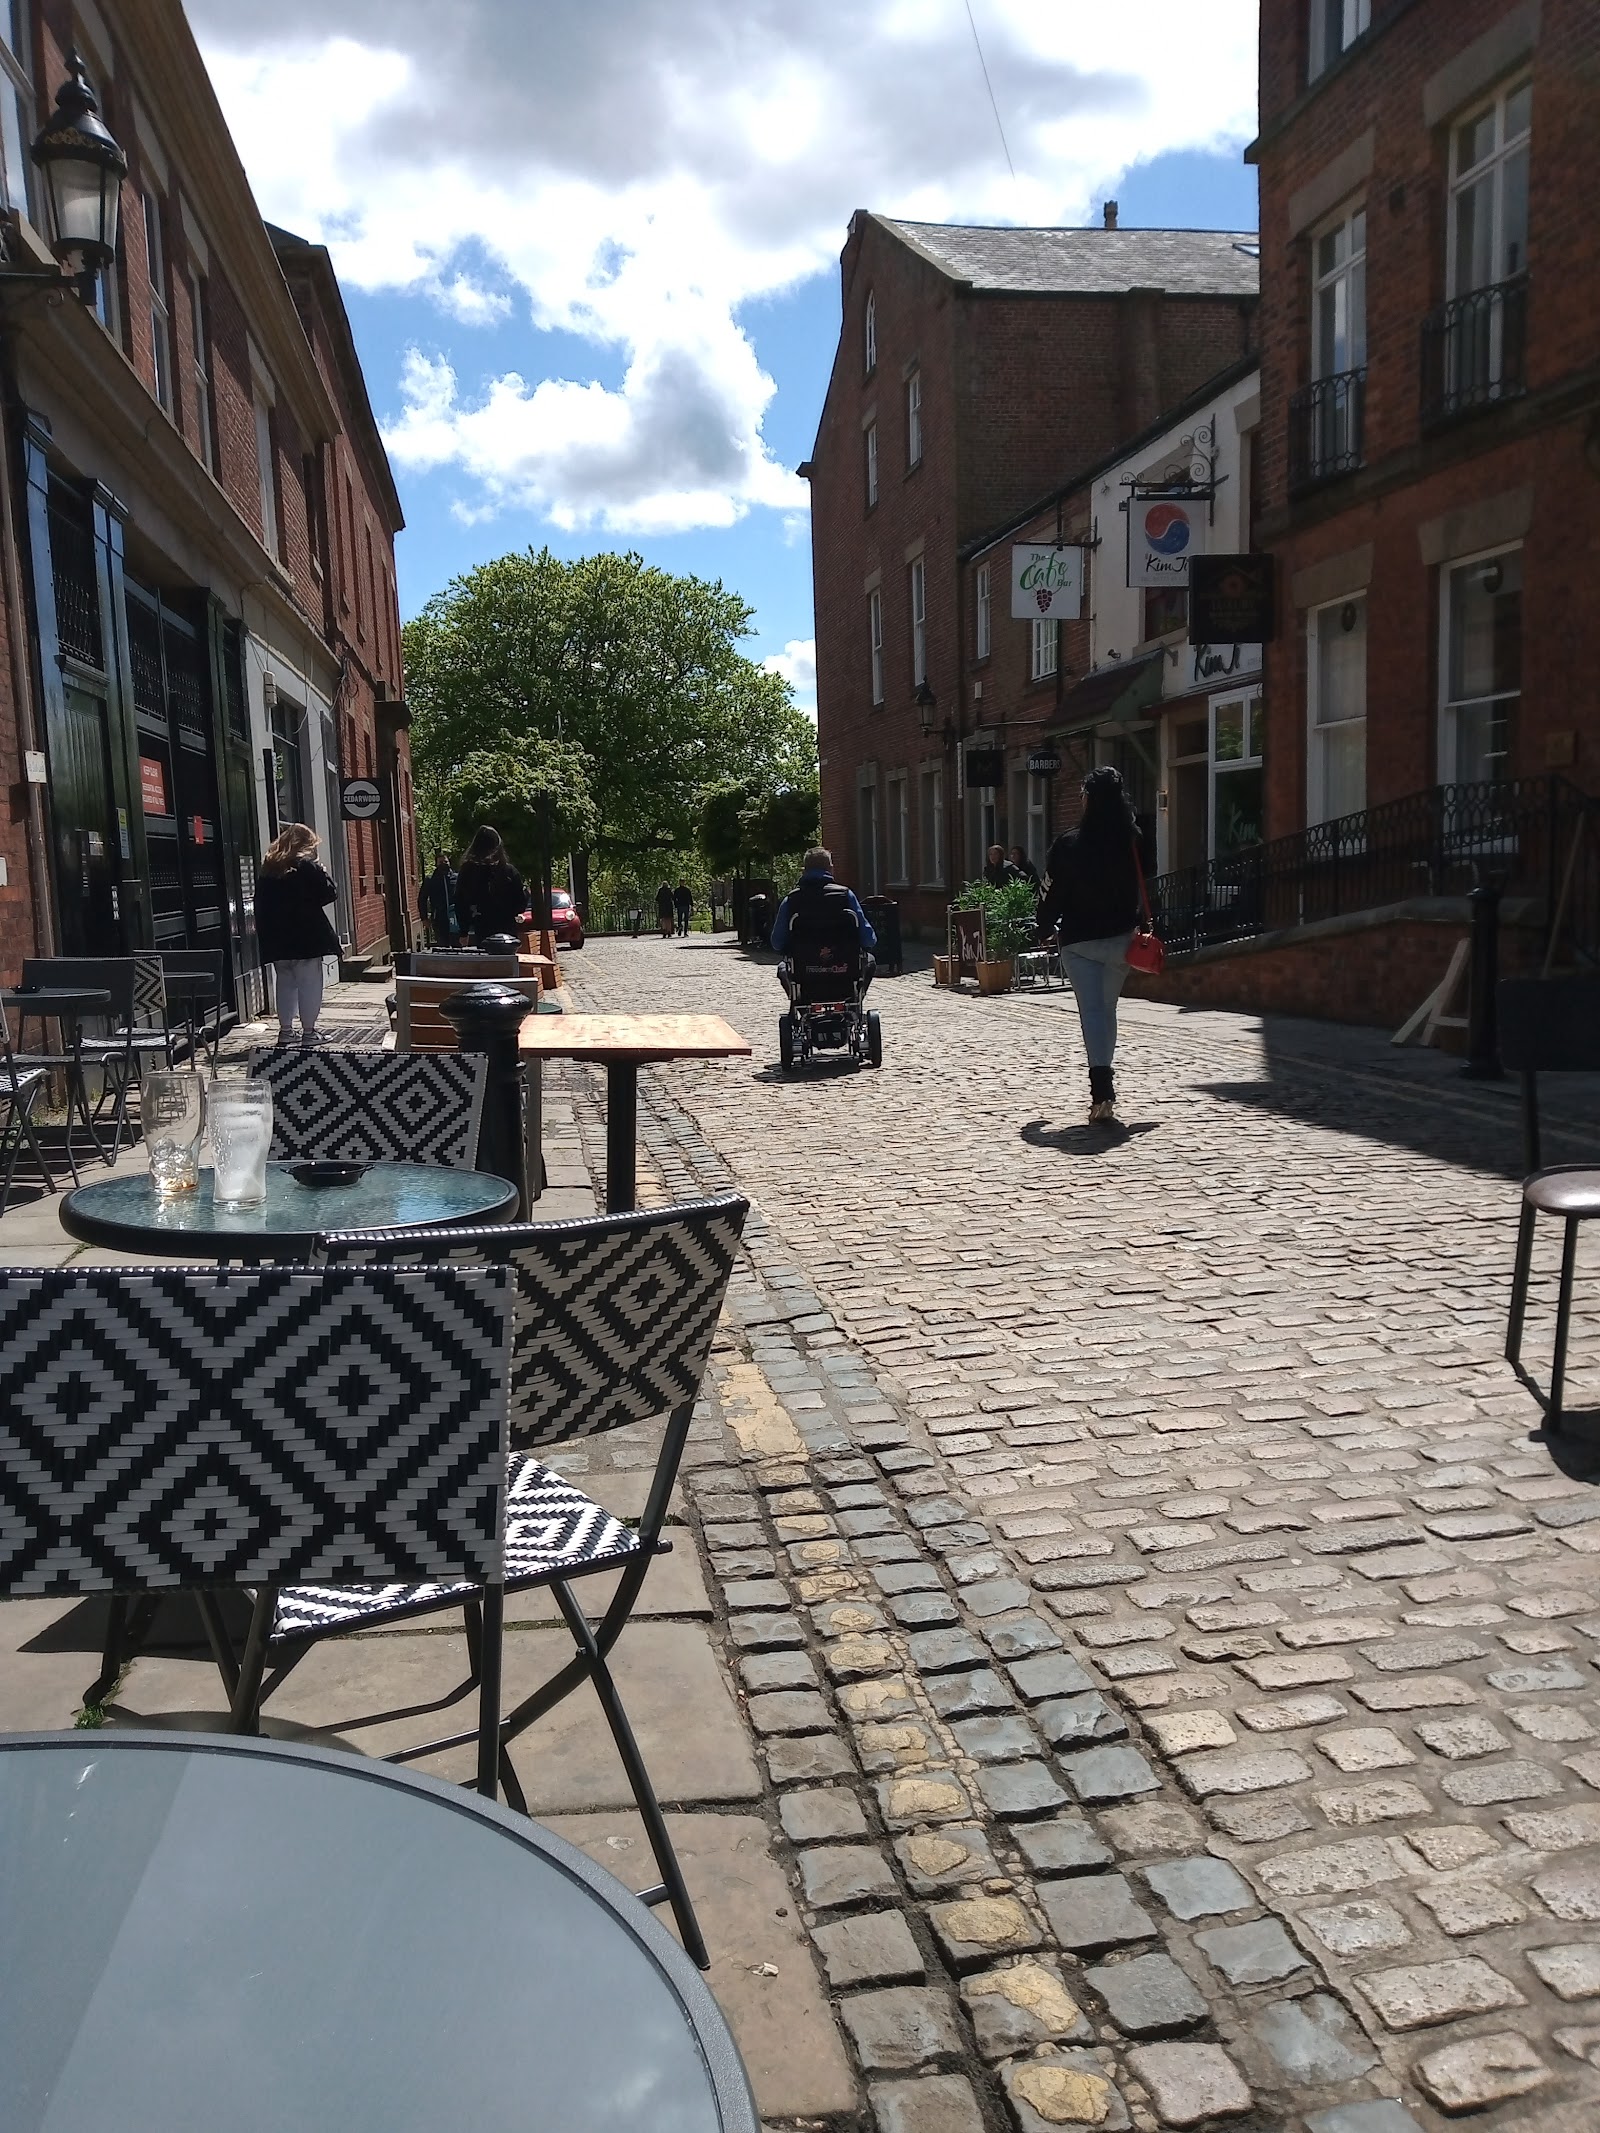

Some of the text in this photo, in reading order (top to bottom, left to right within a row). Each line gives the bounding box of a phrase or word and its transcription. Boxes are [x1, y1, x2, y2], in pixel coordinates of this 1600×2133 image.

[1030, 553, 1046, 561] The
[1020, 552, 1068, 590] Cafe
[1057, 579, 1072, 587] Bar
[1029, 759, 1061, 770] BARBERS
[343, 794, 381, 803] CEDARWOOD
